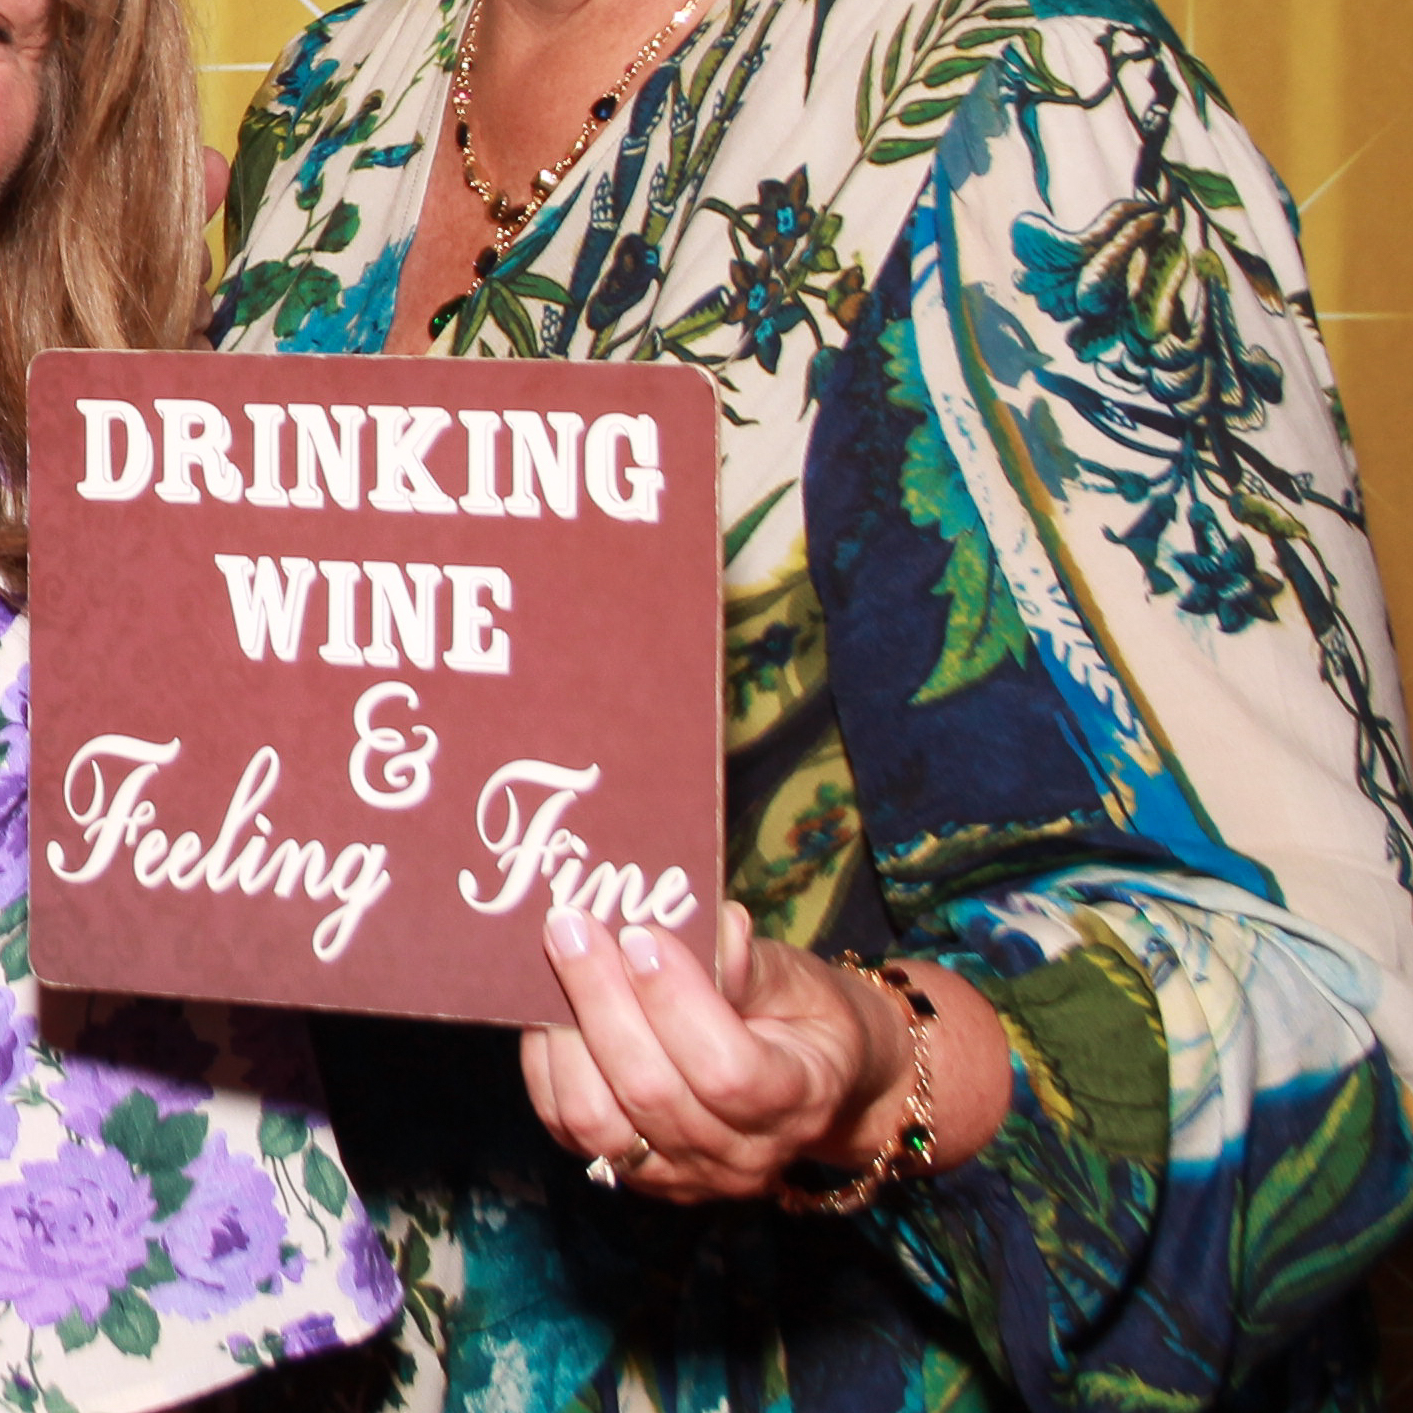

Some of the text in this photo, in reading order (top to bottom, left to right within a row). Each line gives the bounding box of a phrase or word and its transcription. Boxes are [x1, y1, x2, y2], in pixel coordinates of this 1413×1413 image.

[76, 398, 665, 523] DRINKING
[215, 554, 513, 674] WINE
[348, 681, 440, 809] &
[46, 733, 699, 963] Feeling Fine
